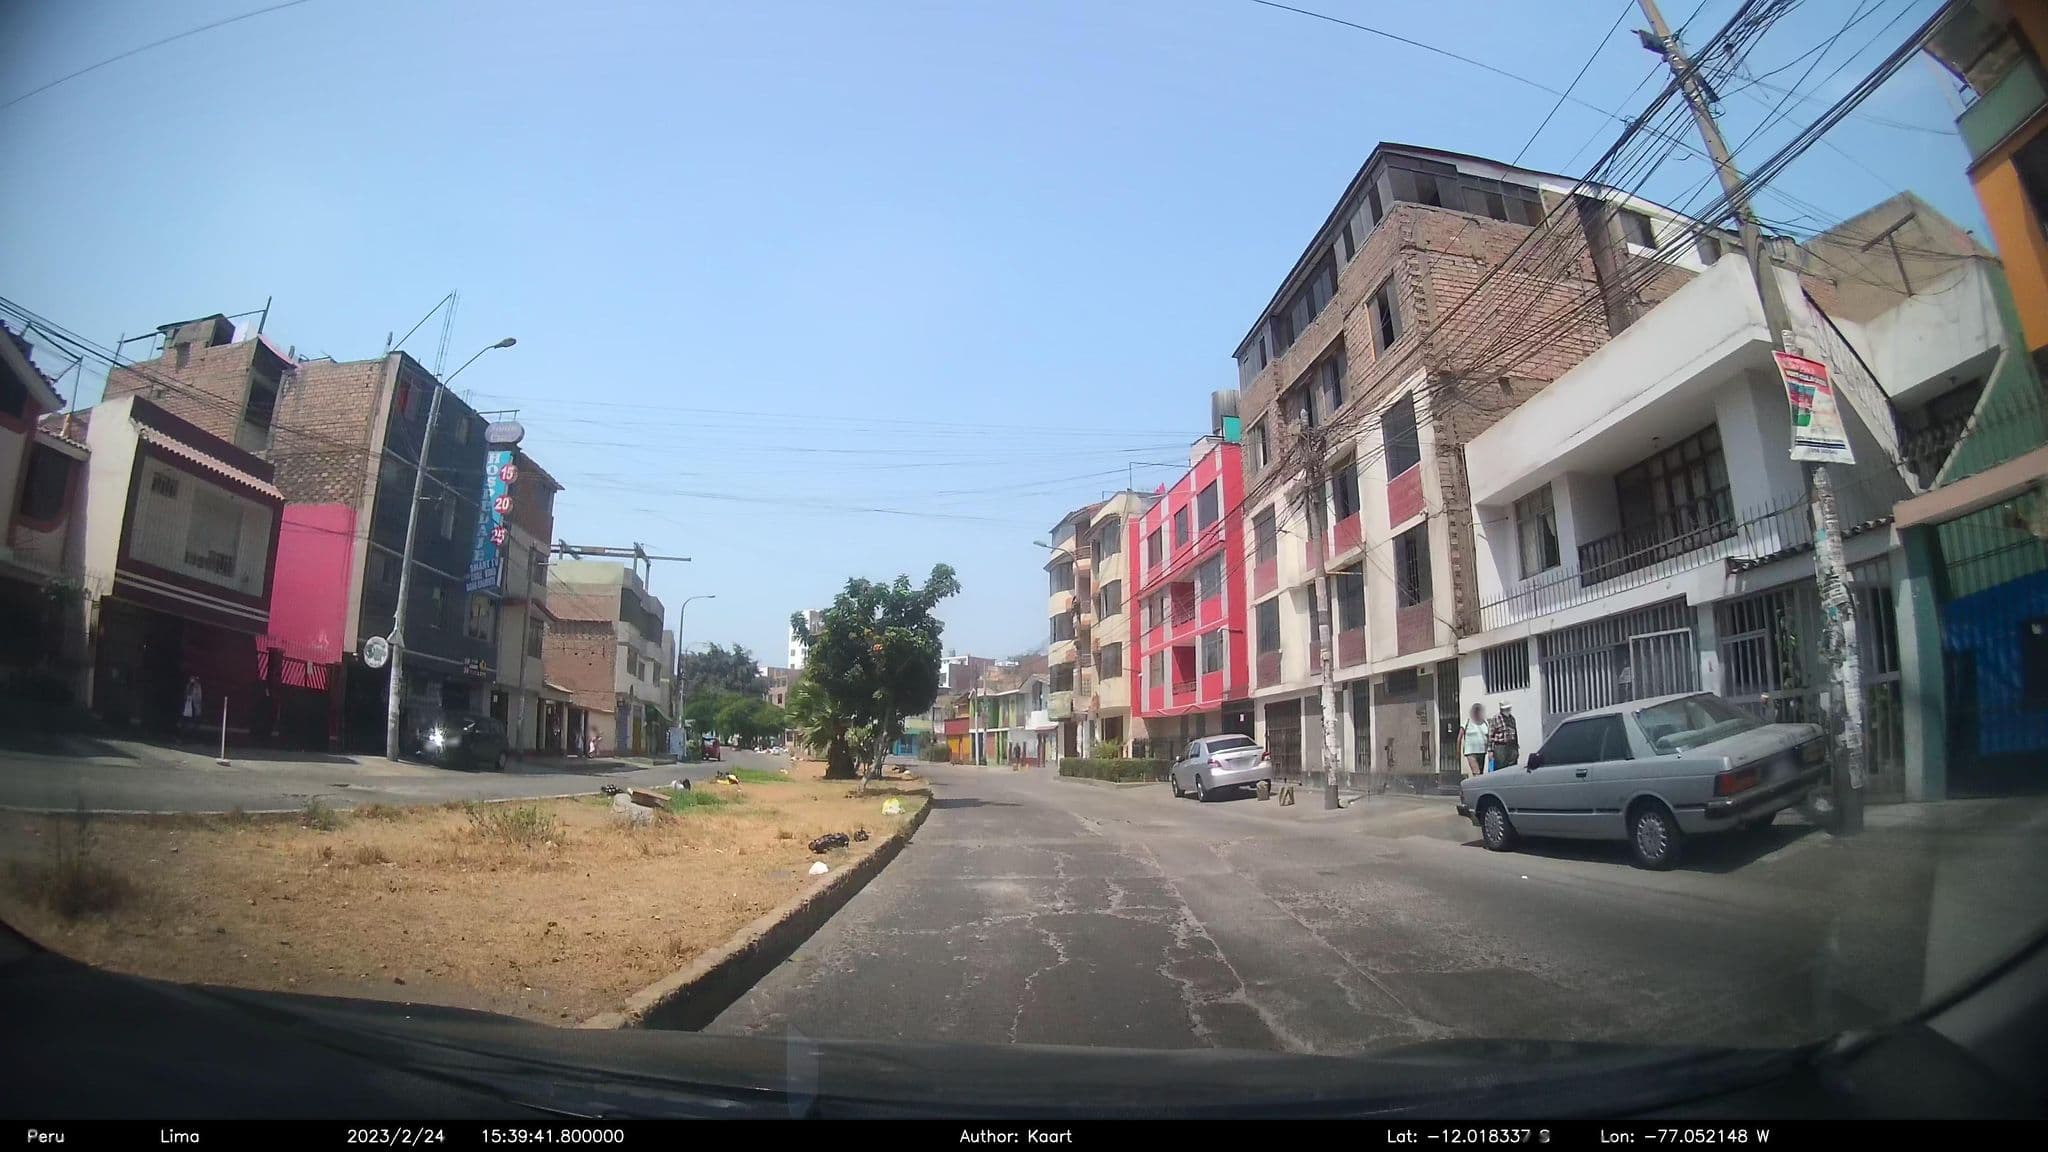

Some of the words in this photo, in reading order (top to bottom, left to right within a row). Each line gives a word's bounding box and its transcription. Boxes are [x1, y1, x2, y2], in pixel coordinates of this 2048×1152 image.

[501, 466, 513, 480] 15
[473, 451, 500, 560] HOSPEDAJE
[494, 497, 509, 510] 20
[490, 529, 505, 544] 25
